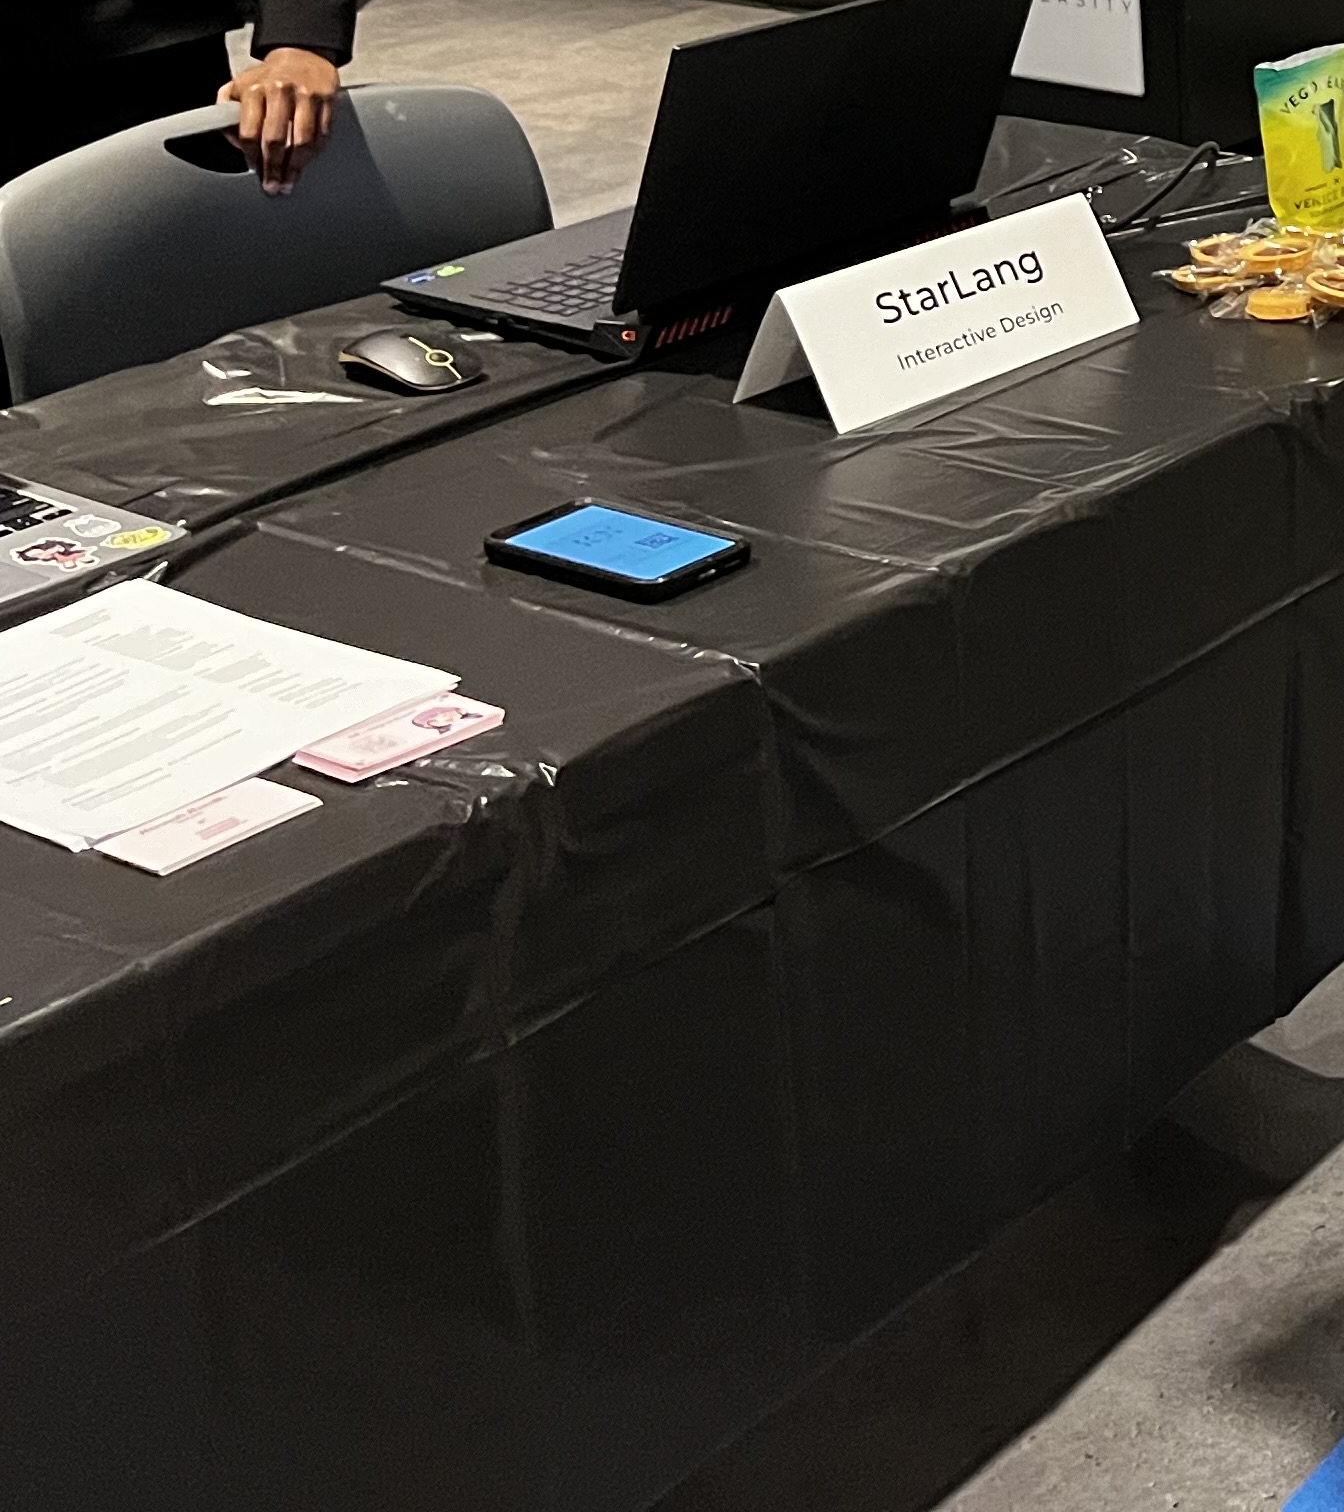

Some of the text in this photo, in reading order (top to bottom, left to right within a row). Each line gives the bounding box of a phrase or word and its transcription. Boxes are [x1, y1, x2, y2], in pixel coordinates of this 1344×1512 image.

[875, 250, 1044, 324] StarLang
[896, 302, 1064, 370] Interactive Design
